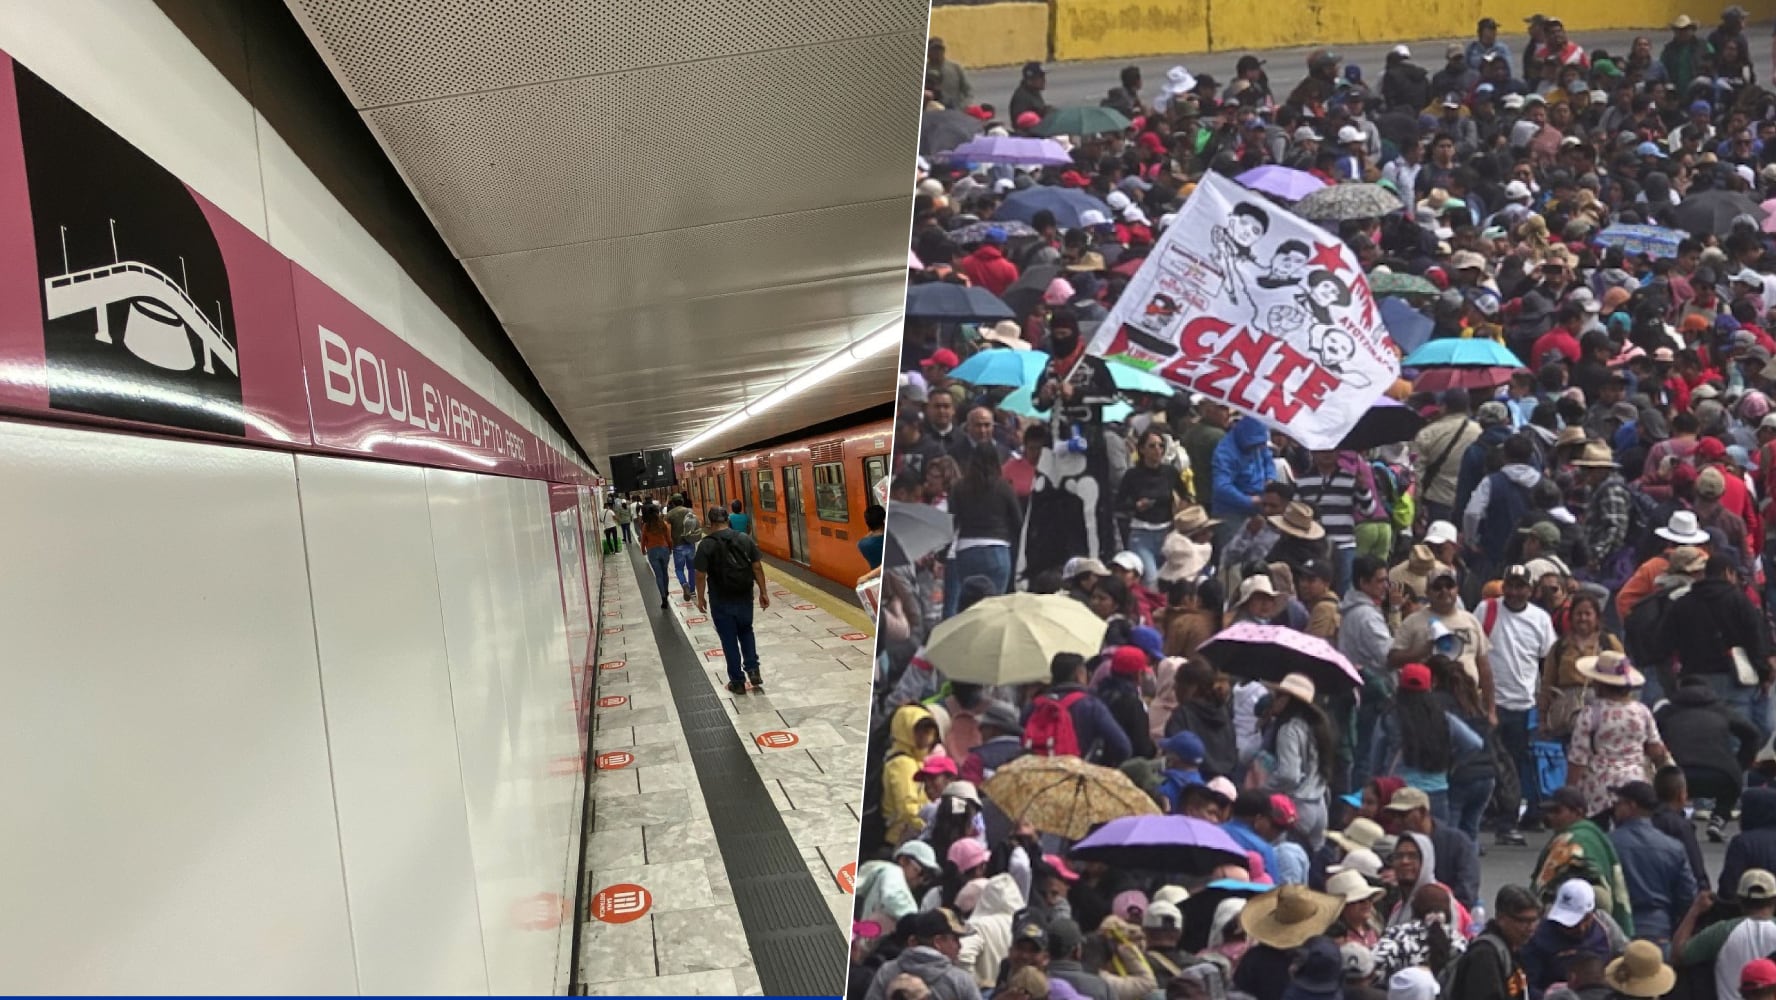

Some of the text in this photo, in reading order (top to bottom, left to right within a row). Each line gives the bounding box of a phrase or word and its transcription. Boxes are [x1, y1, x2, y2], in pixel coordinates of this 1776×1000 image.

[318, 324, 526, 462] BOULEVARD PTO. AEREO
[1160, 356, 1304, 424] EZLN
[1179, 316, 1342, 412] CNTE
